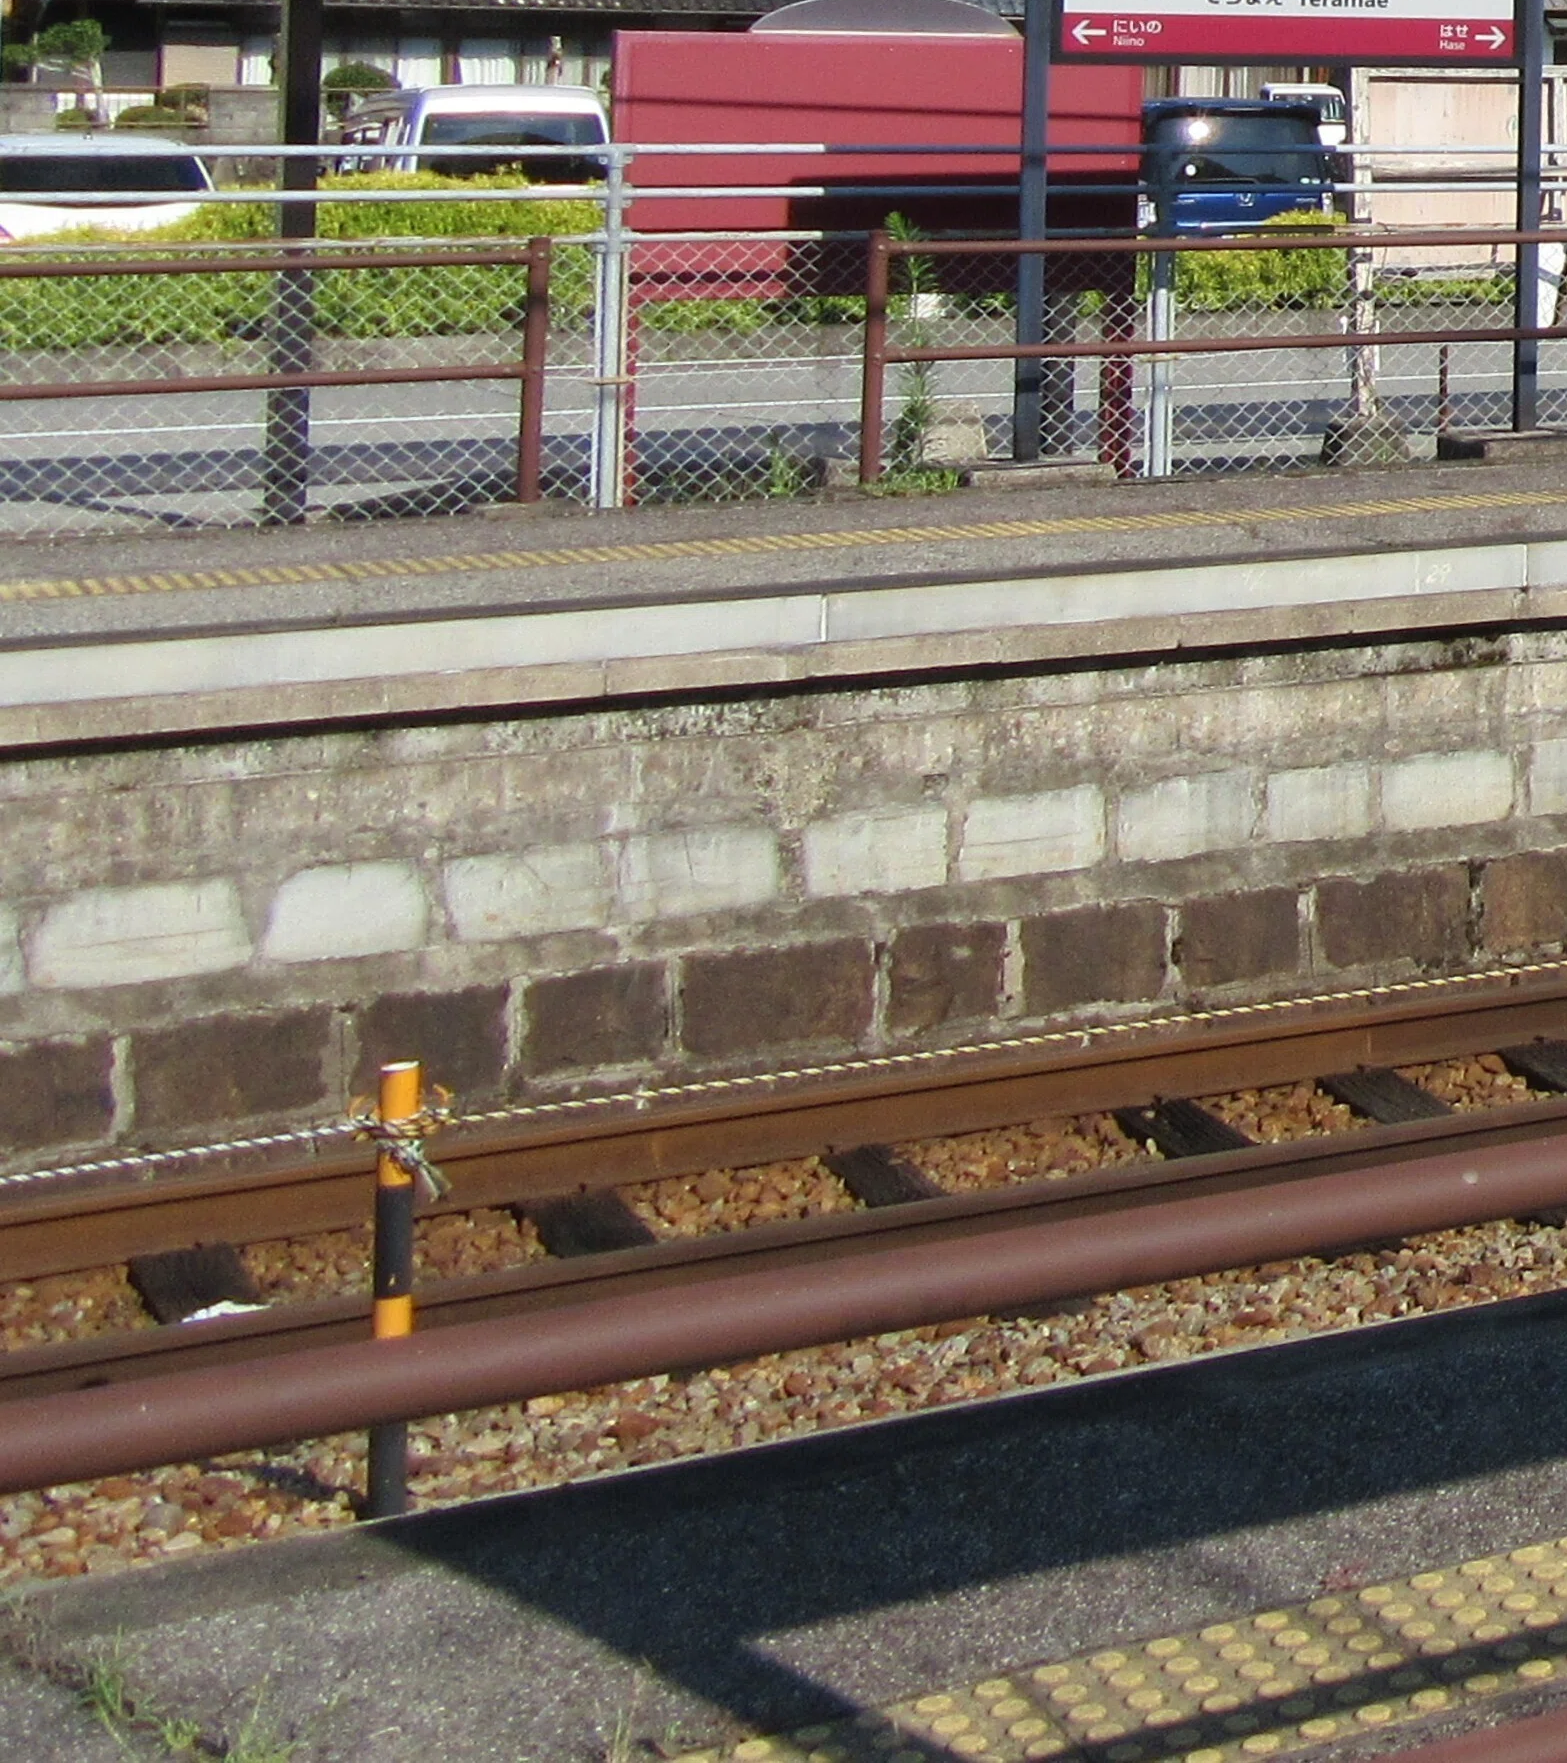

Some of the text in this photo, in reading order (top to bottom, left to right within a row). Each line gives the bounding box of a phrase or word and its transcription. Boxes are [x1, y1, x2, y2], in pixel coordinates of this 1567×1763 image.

[1112, 19, 1163, 34] にいの
[1439, 24, 1470, 38] はせ
[1112, 34, 1146, 47] Niino
[1439, 39, 1467, 51] Hase
